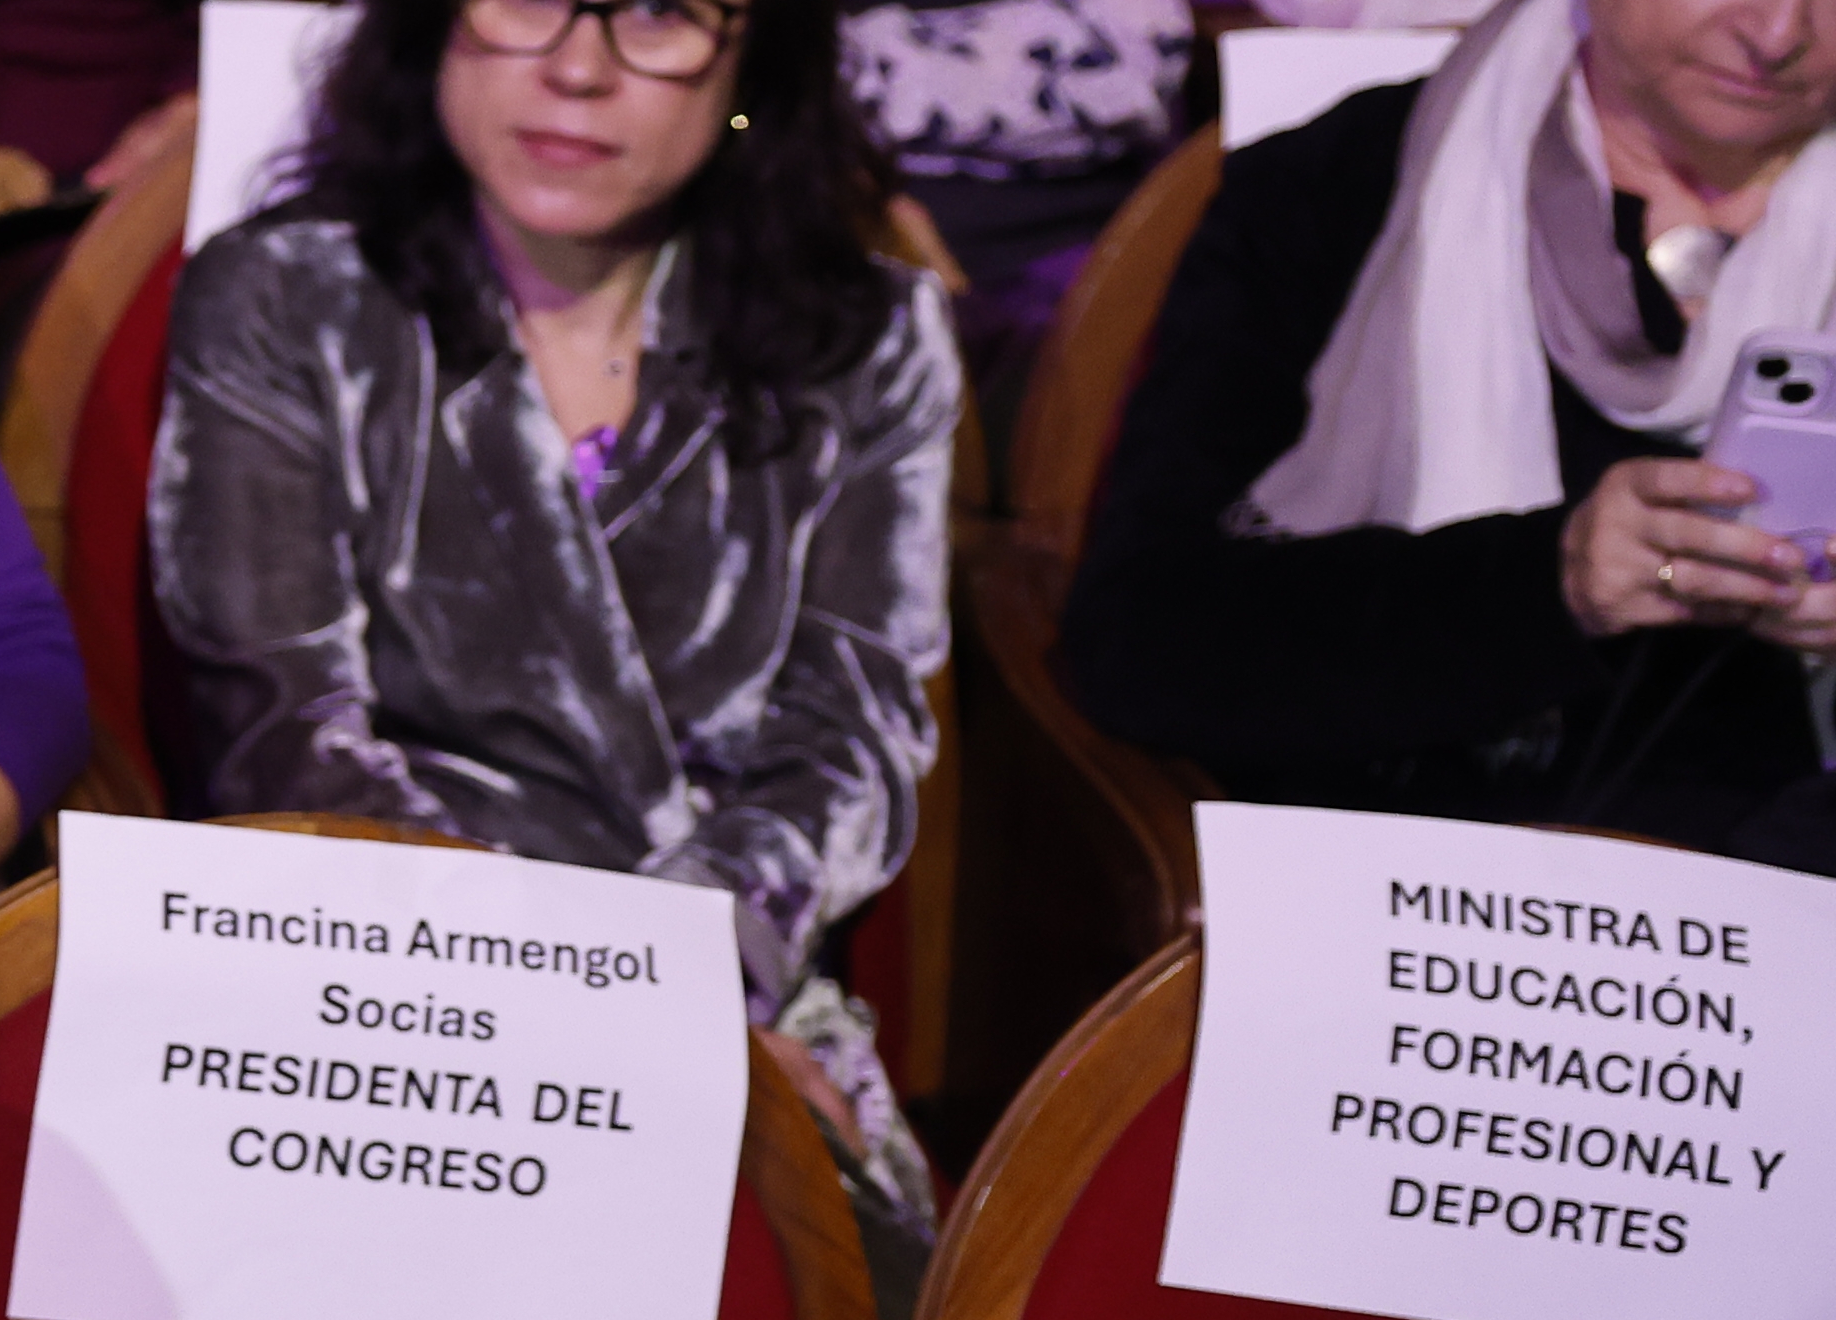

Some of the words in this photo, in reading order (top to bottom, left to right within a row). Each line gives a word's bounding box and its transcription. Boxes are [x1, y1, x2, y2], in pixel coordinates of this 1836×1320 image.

[161, 890, 391, 955] Francina
[404, 917, 660, 990] Armengol
[1388, 877, 1663, 954] MINISTRA
[1677, 916, 1752, 967] DE
[317, 983, 497, 1042] Socias
[1387, 948, 1754, 1044] EDUCACIÓN,
[160, 1041, 504, 1120] PRESIDENTA
[530, 1080, 635, 1133] DEL
[1389, 1022, 1744, 1113] FORMACIÓN
[226, 1125, 548, 1199] CONGRESO
[1329, 1090, 1733, 1188] PROFESIONAL
[1750, 1146, 1787, 1193] Y
[1386, 1175, 1690, 1257] DEPORTES
